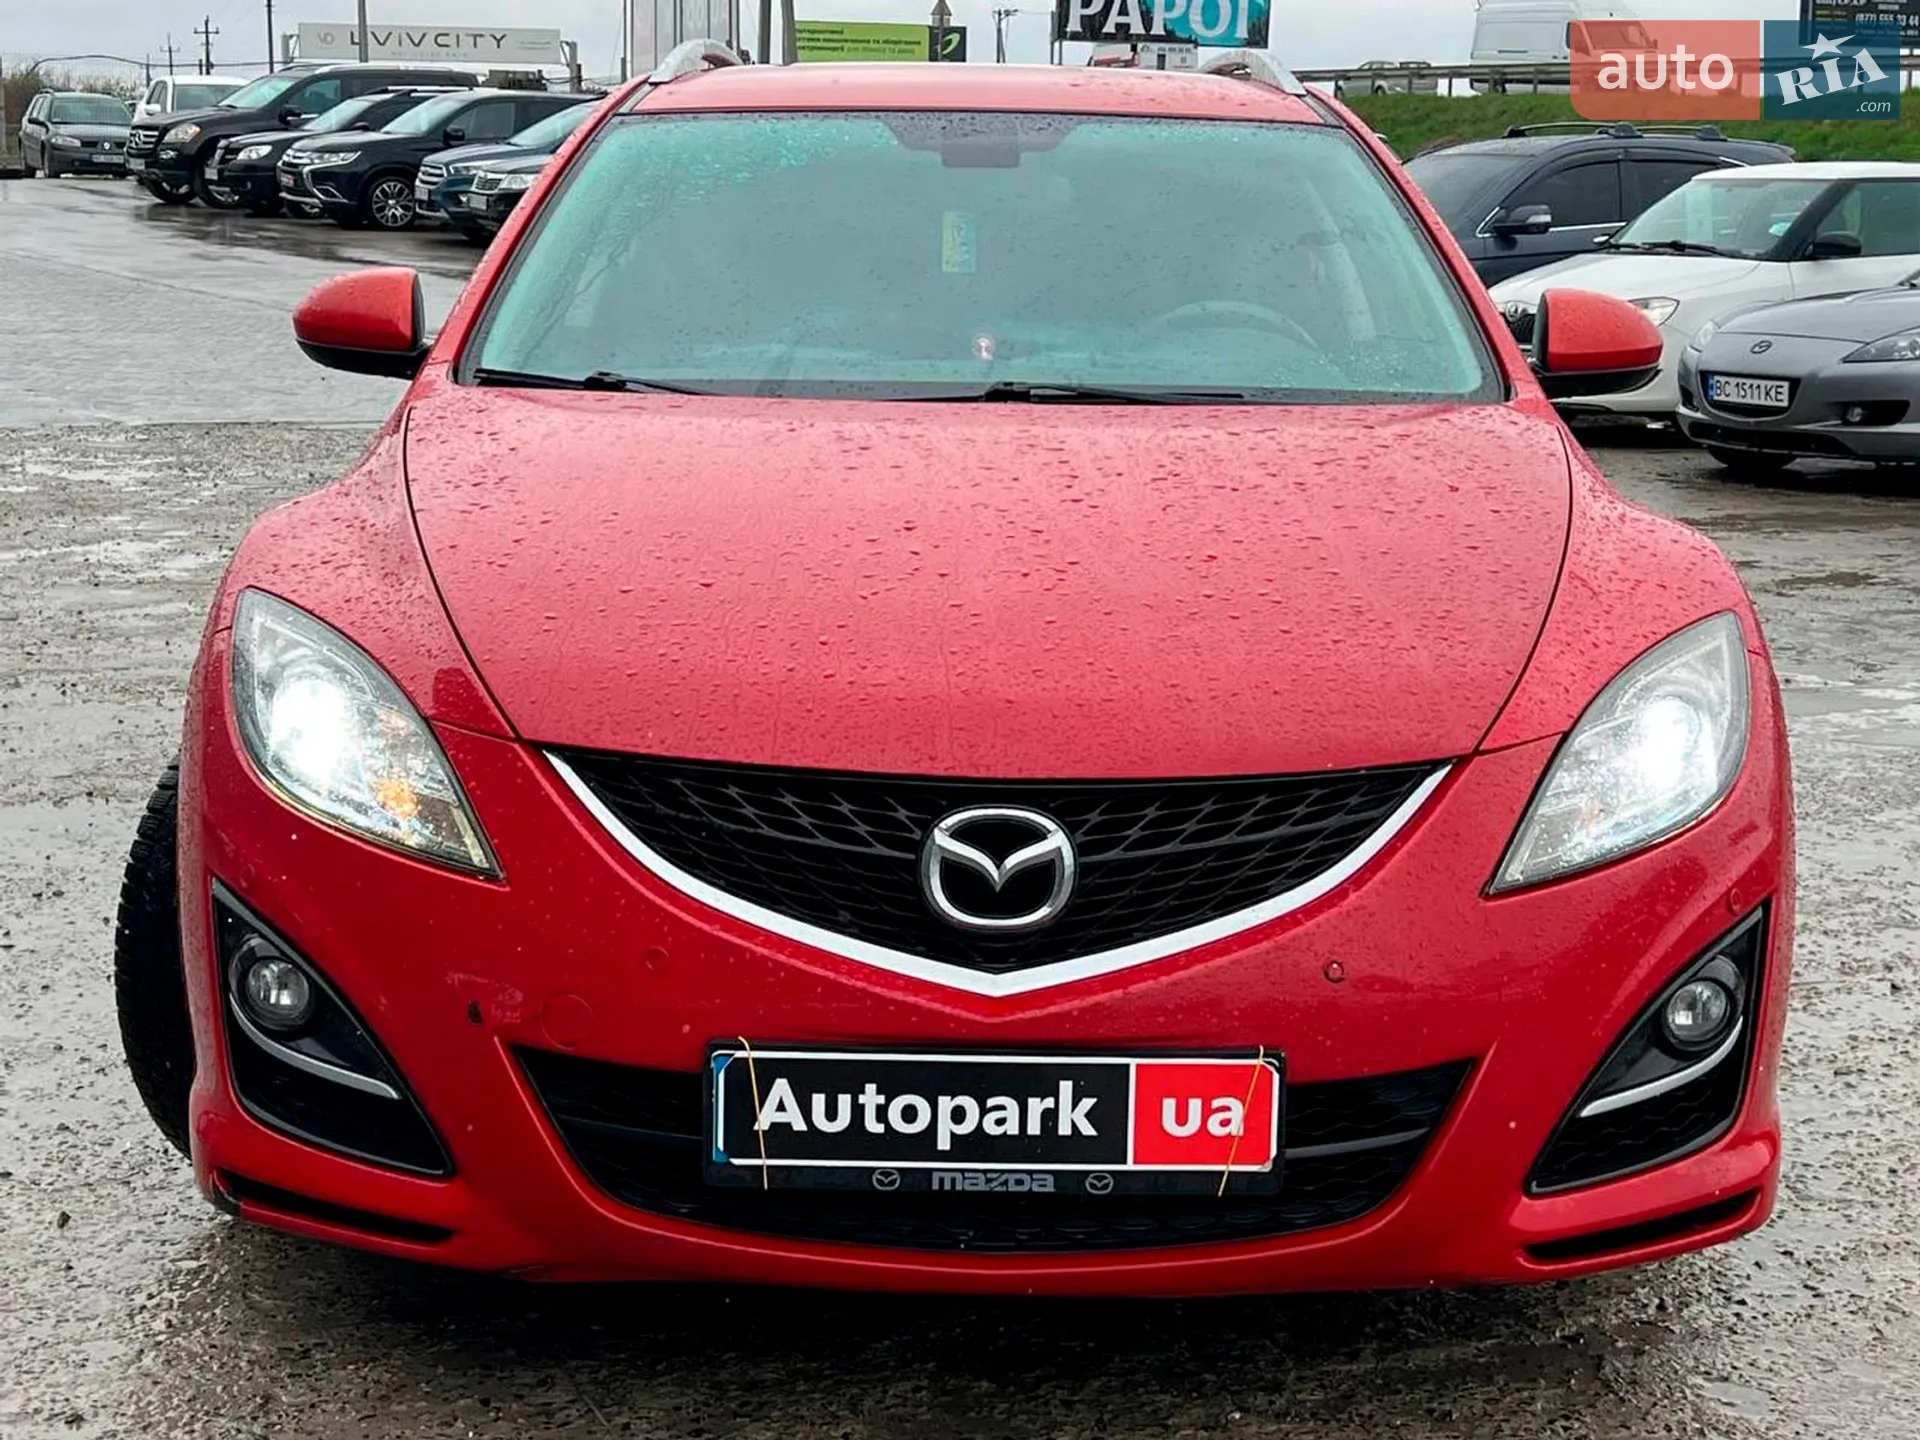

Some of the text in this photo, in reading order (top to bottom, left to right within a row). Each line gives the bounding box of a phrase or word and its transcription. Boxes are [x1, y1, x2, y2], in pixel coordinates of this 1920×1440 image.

[350, 30, 508, 50] LVIVCITY
[1715, 380, 1785, 402] BC 1511 KE
[753, 1077, 1244, 1151] Autopark ua
